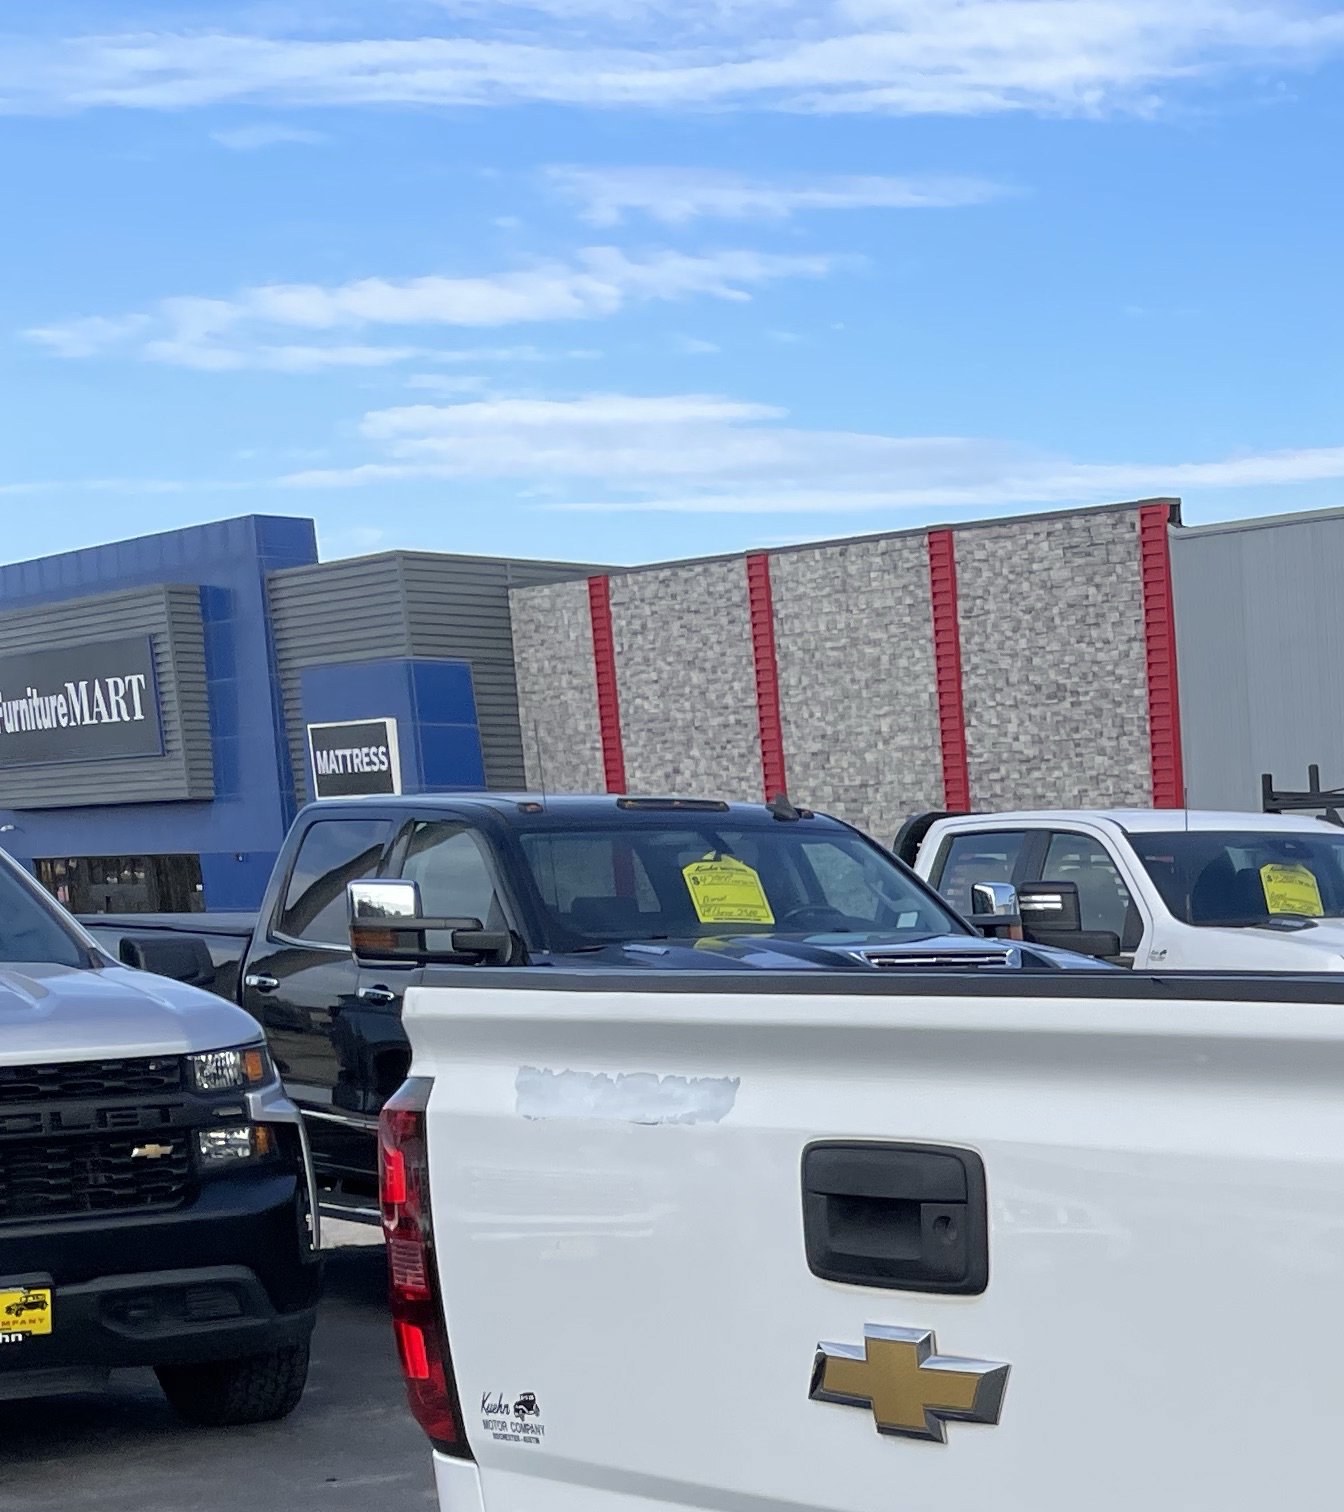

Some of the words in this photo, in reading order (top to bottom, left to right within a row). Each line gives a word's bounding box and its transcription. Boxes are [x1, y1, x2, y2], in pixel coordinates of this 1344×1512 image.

[316, 745, 389, 775] MATTRESS
[481, 1391, 510, 1416] Kuehn
[482, 1419, 508, 1432] MOTOR
[510, 1421, 545, 1437] COMPANY
